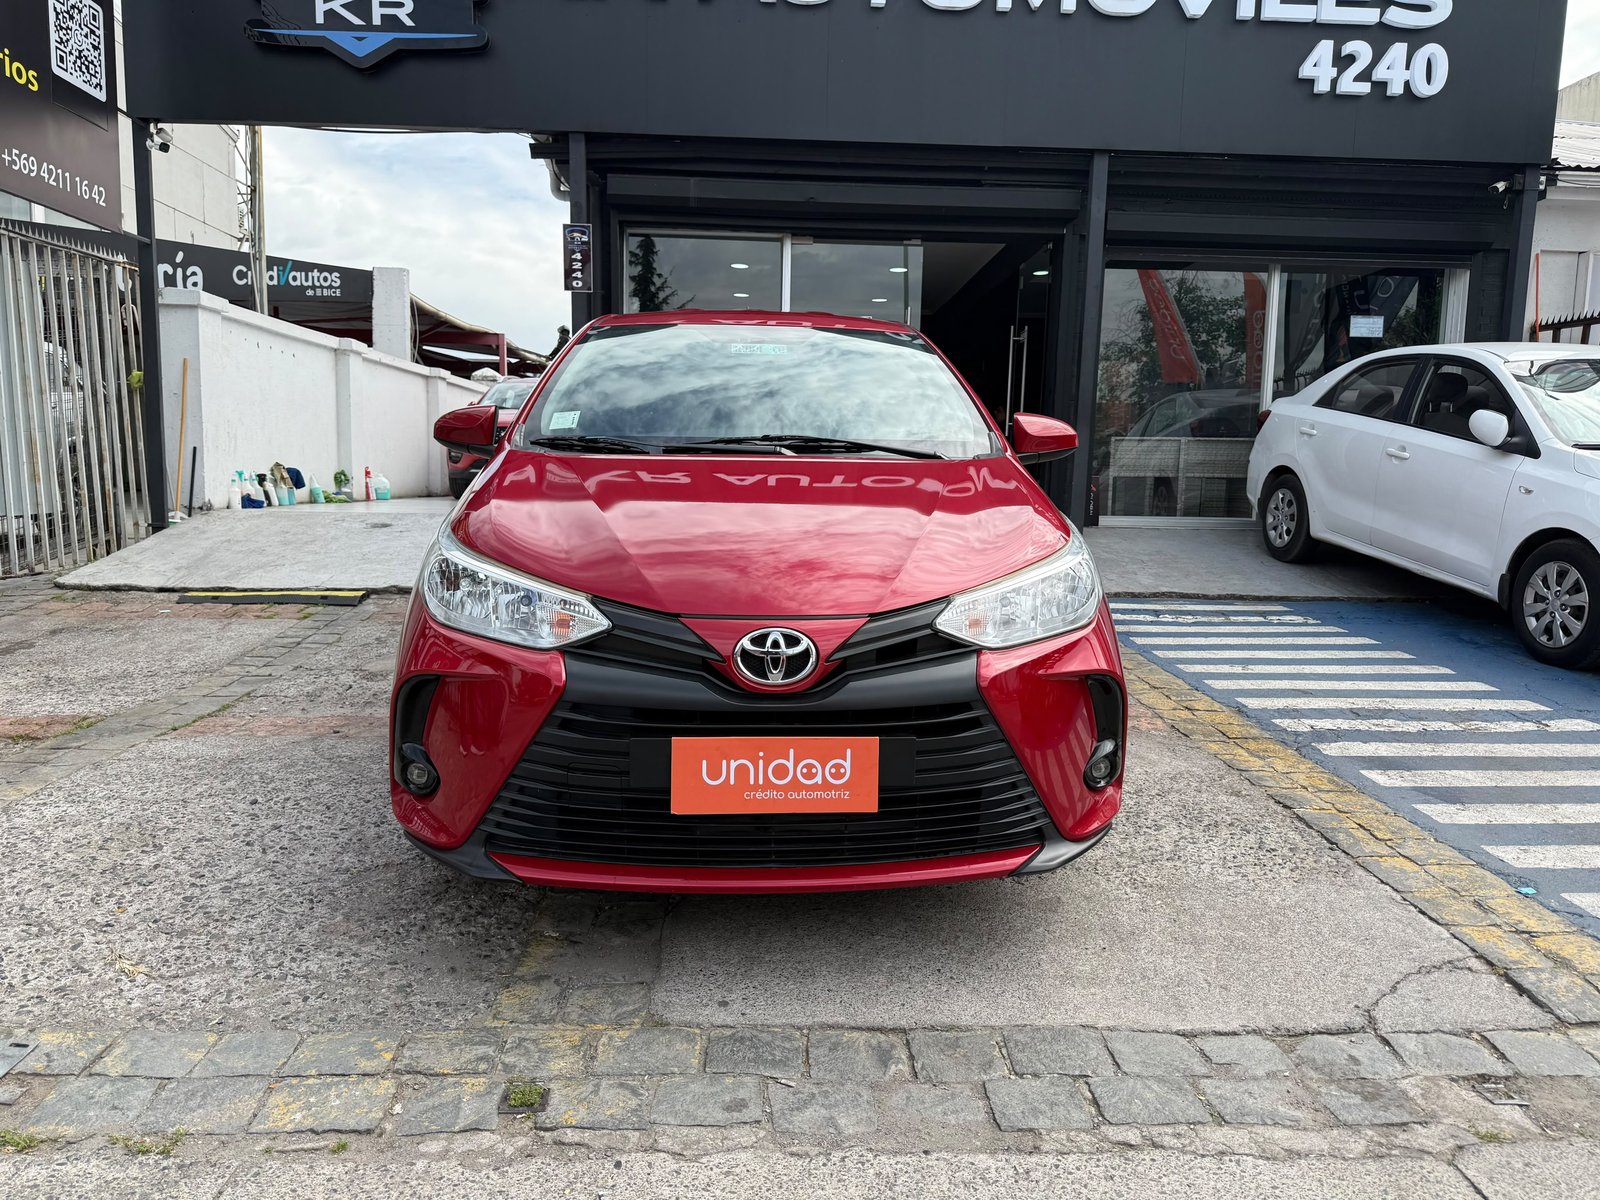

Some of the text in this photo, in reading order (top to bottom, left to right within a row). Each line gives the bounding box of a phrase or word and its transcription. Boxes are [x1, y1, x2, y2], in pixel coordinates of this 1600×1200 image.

[0, 48, 38, 92] ios
[1298, 39, 1449, 98] 4240
[1, 148, 106, 207] +569 4211 16 42
[571, 252, 583, 288] 4240
[702, 748, 851, 786] unidad
[744, 788, 850, 800] crédito automotriz
